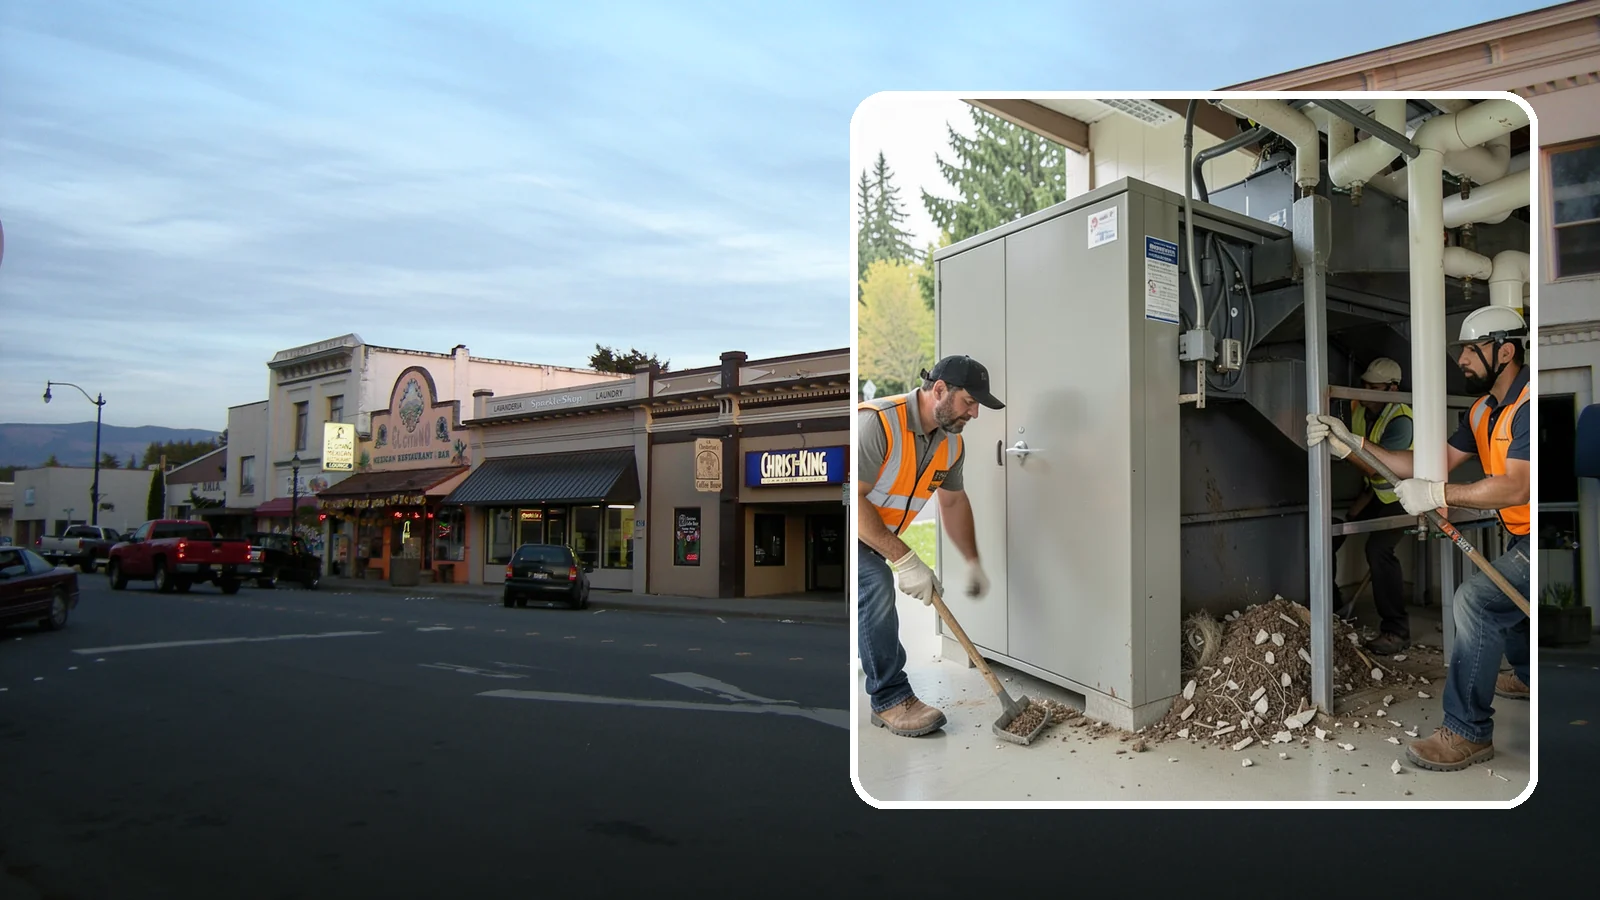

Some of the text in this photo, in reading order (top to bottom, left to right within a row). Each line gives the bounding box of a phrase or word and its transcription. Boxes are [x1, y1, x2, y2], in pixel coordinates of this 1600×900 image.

[561, 394, 583, 405] Shop
[596, 389, 624, 400] LAUNDRY
[493, 402, 523, 413] LAVANDERIA
[374, 456, 396, 464] MEXICAN
[398, 452, 433, 462] RESTAURANT
[438, 450, 450, 459] BAR
[761, 450, 828, 478] CHRIST KING
